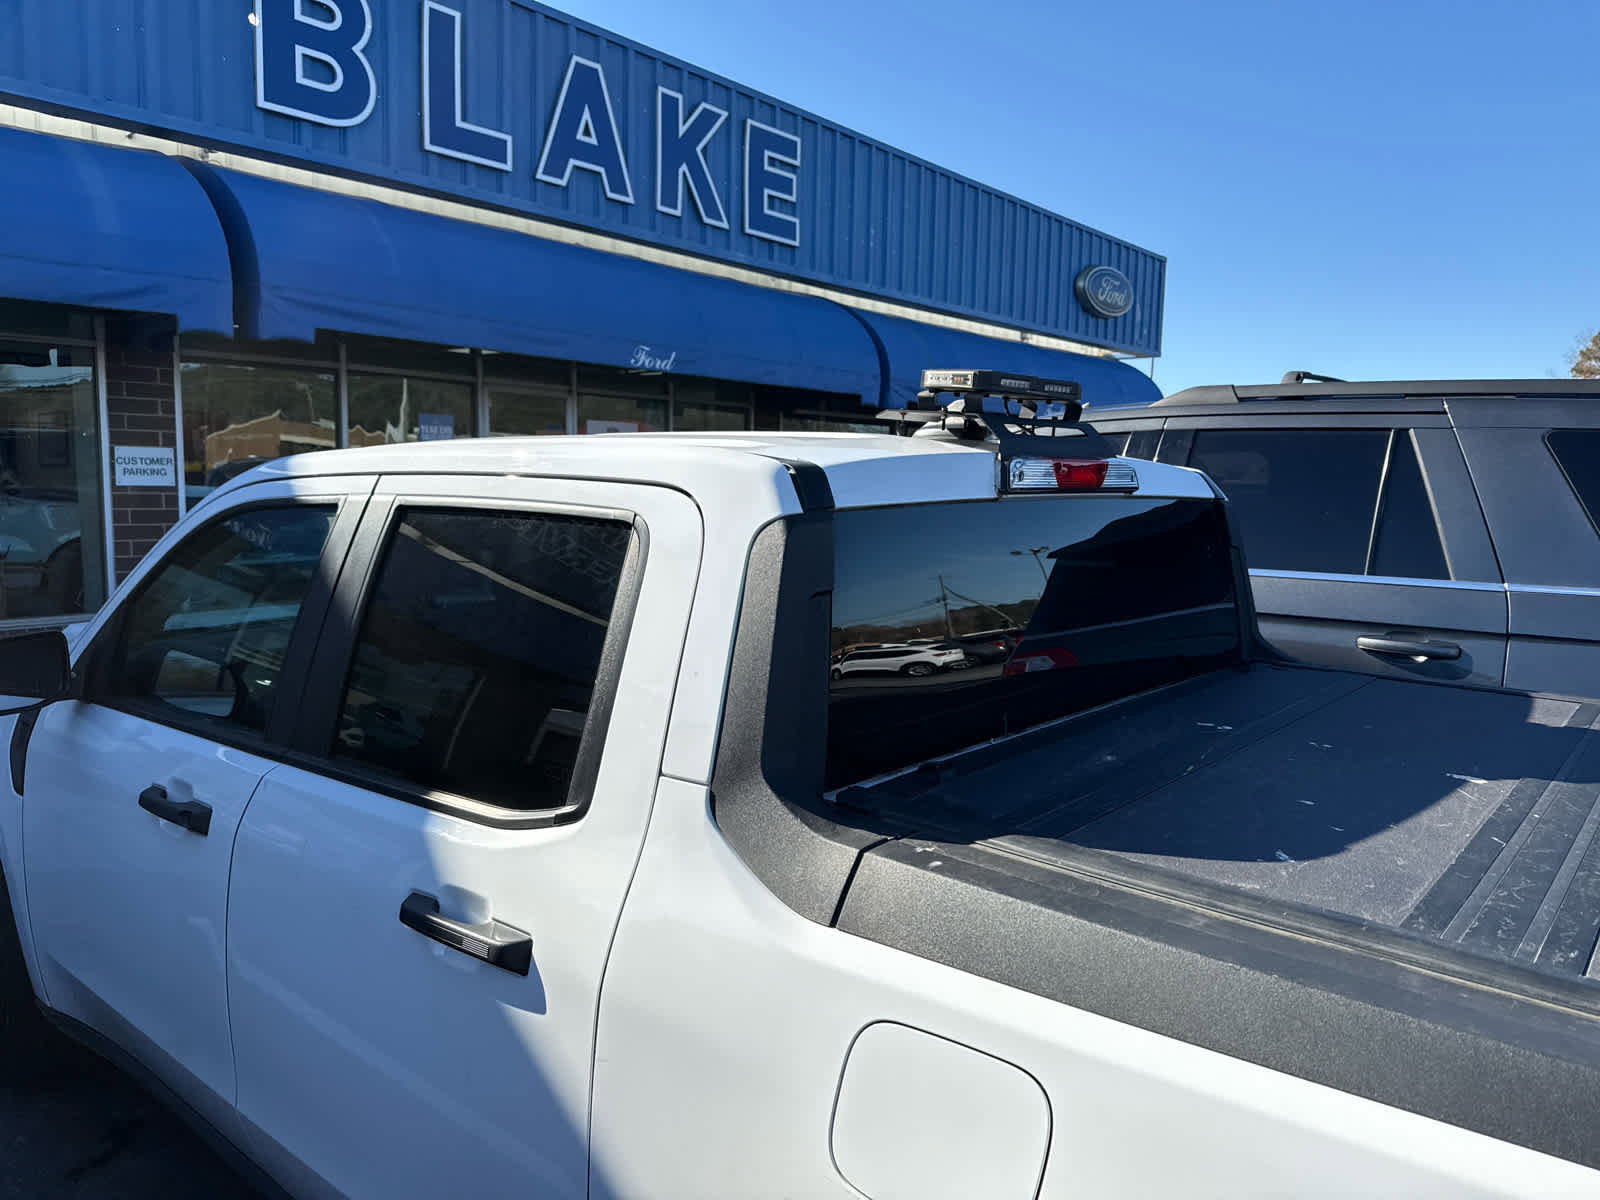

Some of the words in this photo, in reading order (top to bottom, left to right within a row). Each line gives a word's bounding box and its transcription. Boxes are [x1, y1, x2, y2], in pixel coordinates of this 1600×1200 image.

[255, 0, 802, 248] BLAKE
[1098, 276, 1129, 306] Ford
[631, 345, 676, 370] Ford
[115, 456, 173, 466] CUSTOMER
[122, 467, 168, 477] PARKING
